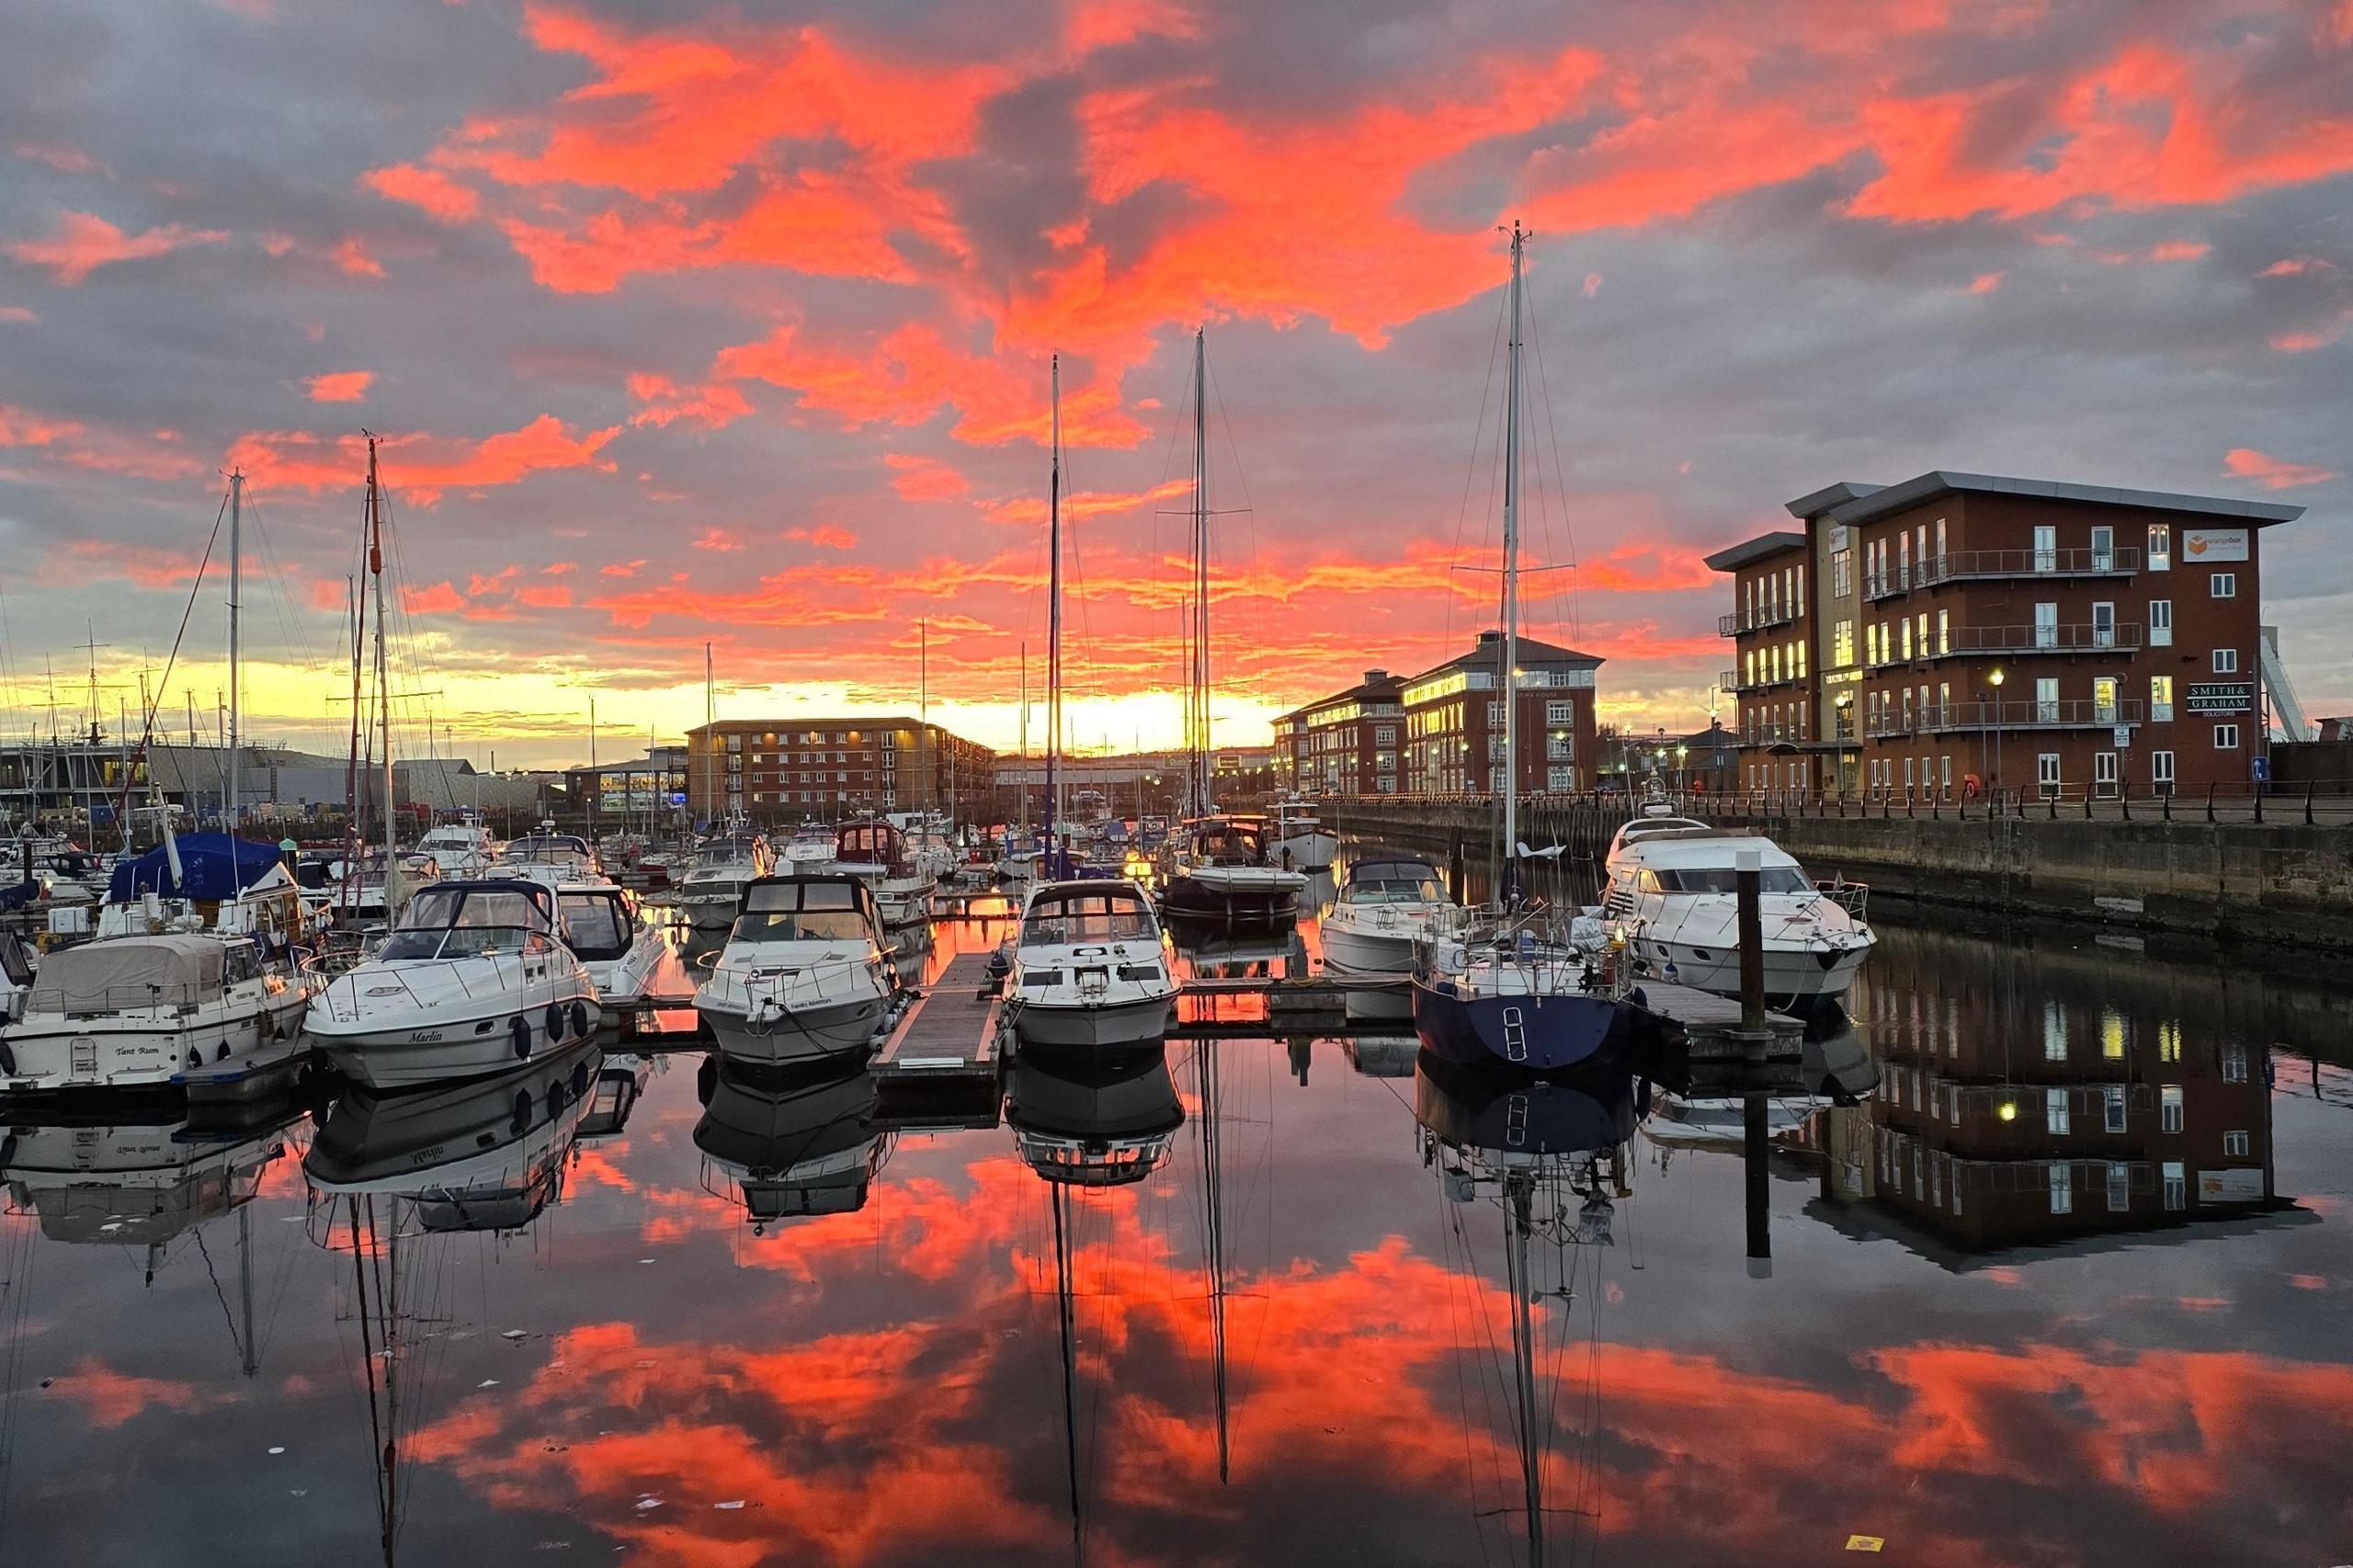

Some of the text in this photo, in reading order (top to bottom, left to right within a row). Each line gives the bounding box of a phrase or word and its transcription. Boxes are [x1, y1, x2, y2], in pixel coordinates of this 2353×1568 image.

[2191, 699, 2246, 708] GRAHAM
[408, 1030, 442, 1043] Marlin
[138, 1047, 159, 1055] Rum
